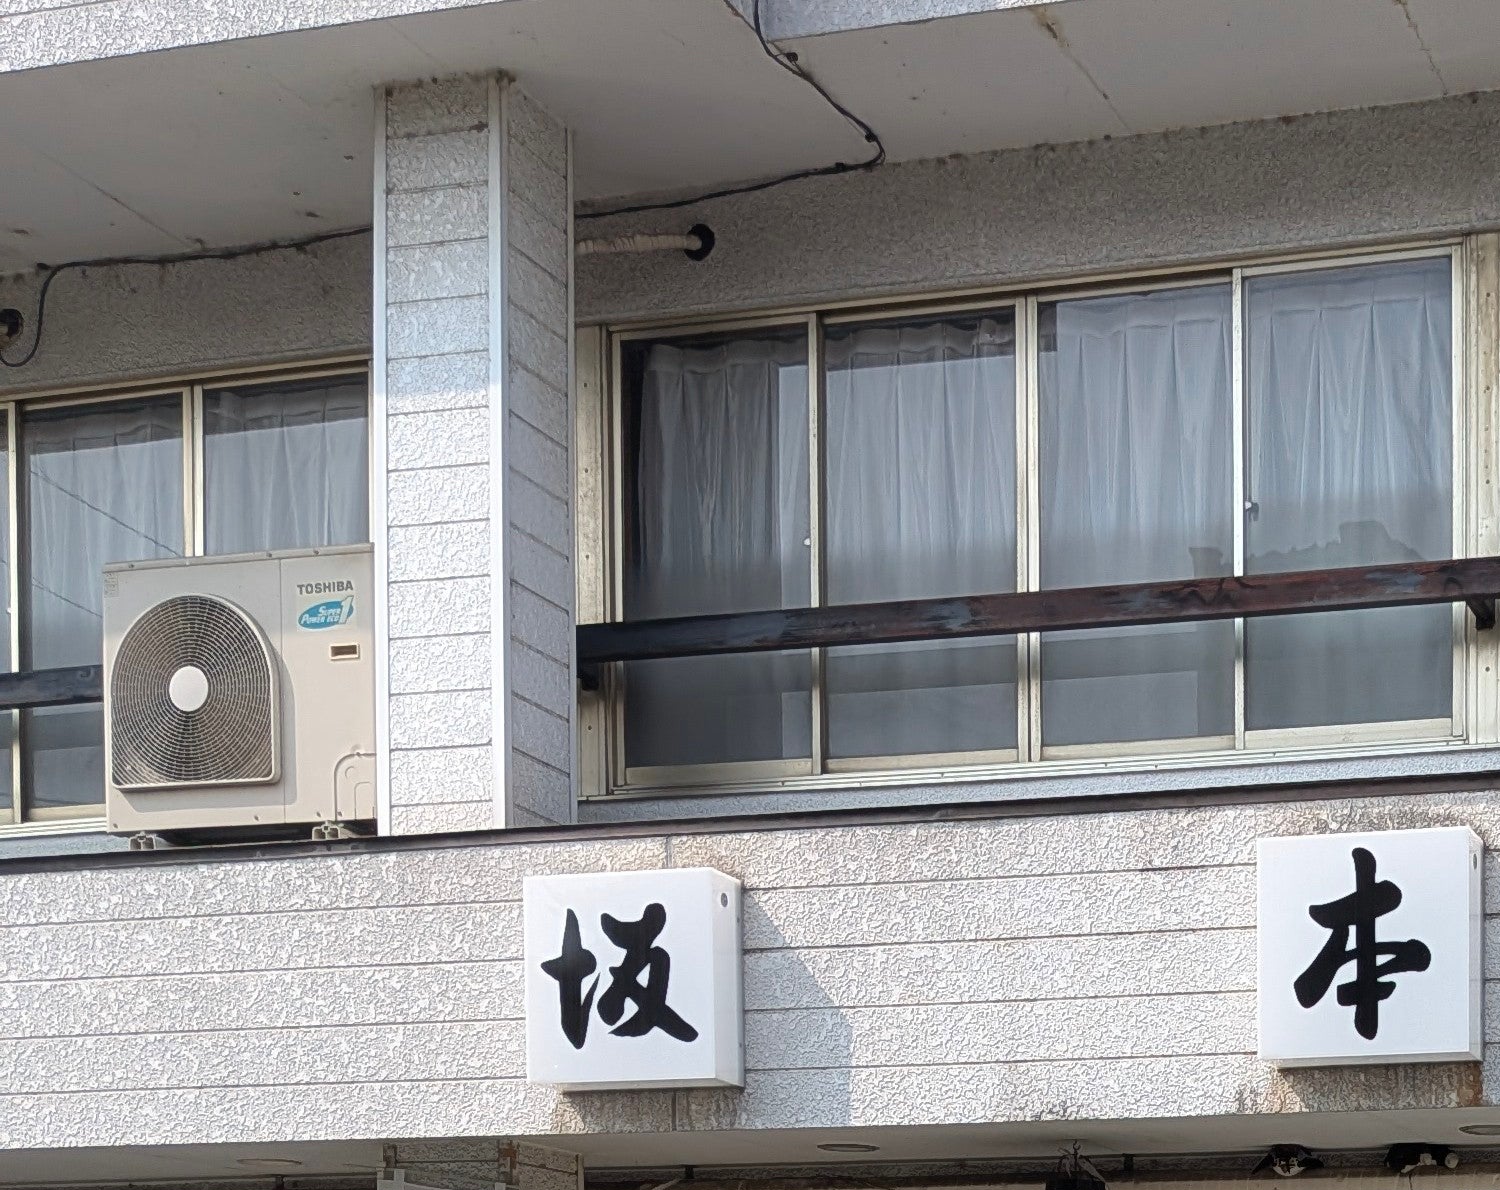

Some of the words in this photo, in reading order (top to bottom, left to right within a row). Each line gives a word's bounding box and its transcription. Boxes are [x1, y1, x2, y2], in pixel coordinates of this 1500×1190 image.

[297, 580, 353, 595] TOSHIBA
[540, 902, 699, 1050] 坂
[1293, 847, 1432, 1040] 本
